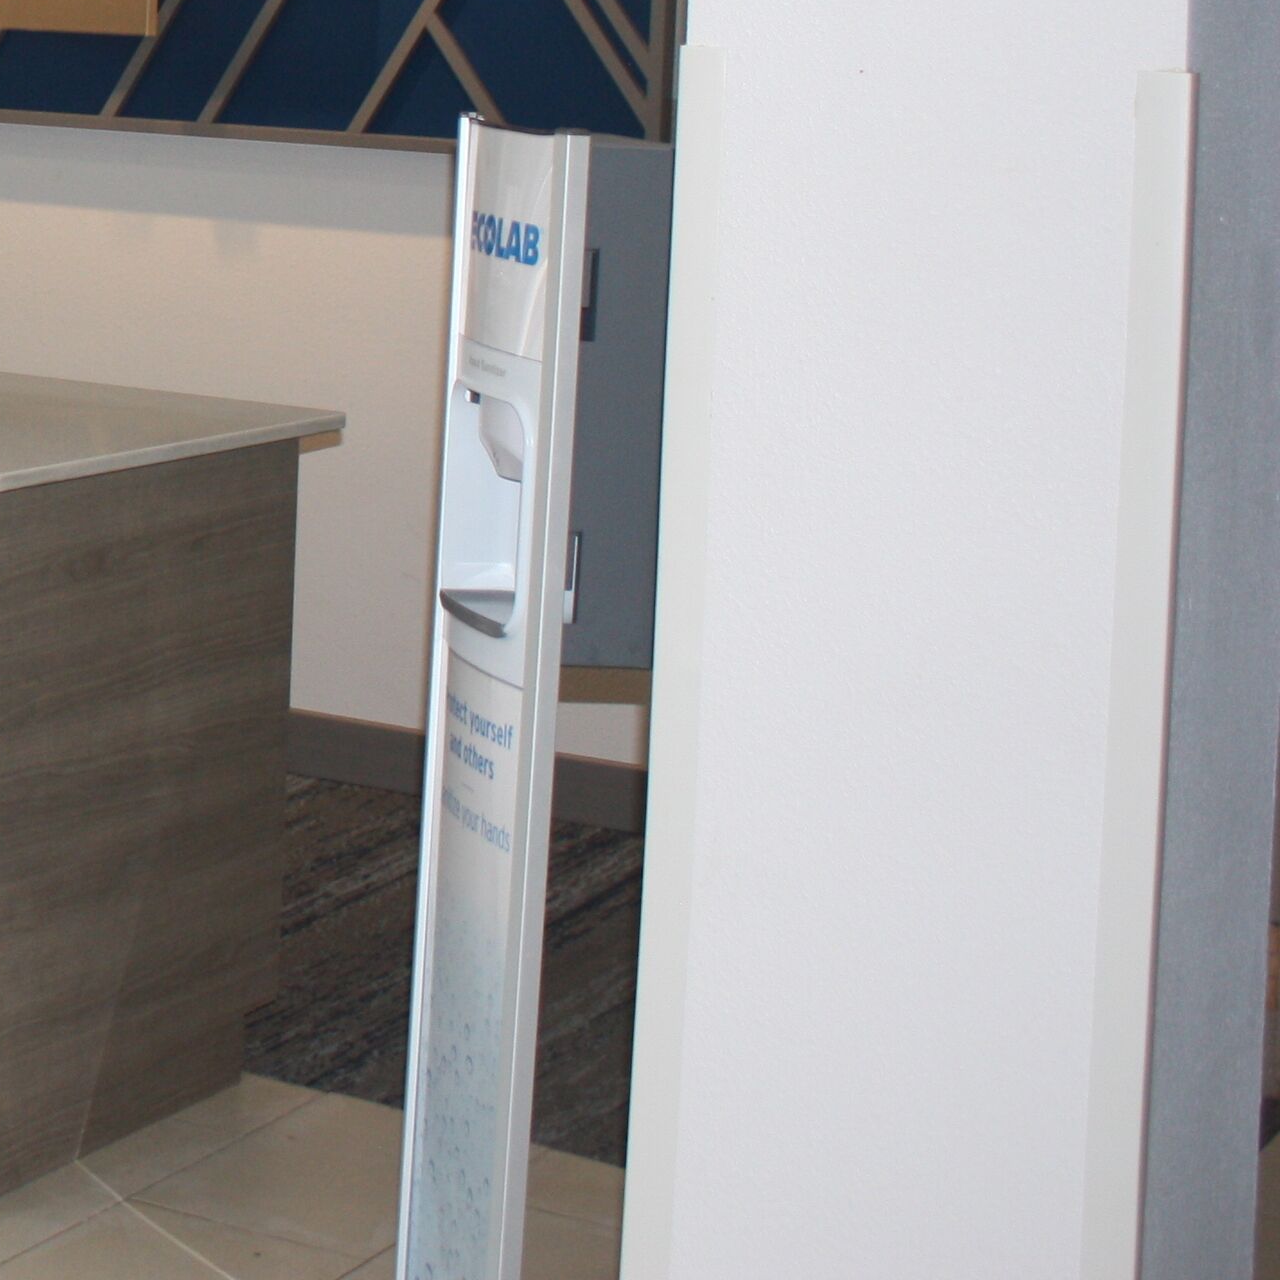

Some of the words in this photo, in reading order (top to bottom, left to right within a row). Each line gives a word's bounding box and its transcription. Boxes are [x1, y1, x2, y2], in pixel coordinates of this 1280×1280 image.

[471, 210, 539, 265] ECOLAB
[470, 710, 513, 749] yourself
[464, 742, 494, 780] others
[462, 803, 478, 832] your
[480, 811, 510, 852] hands
